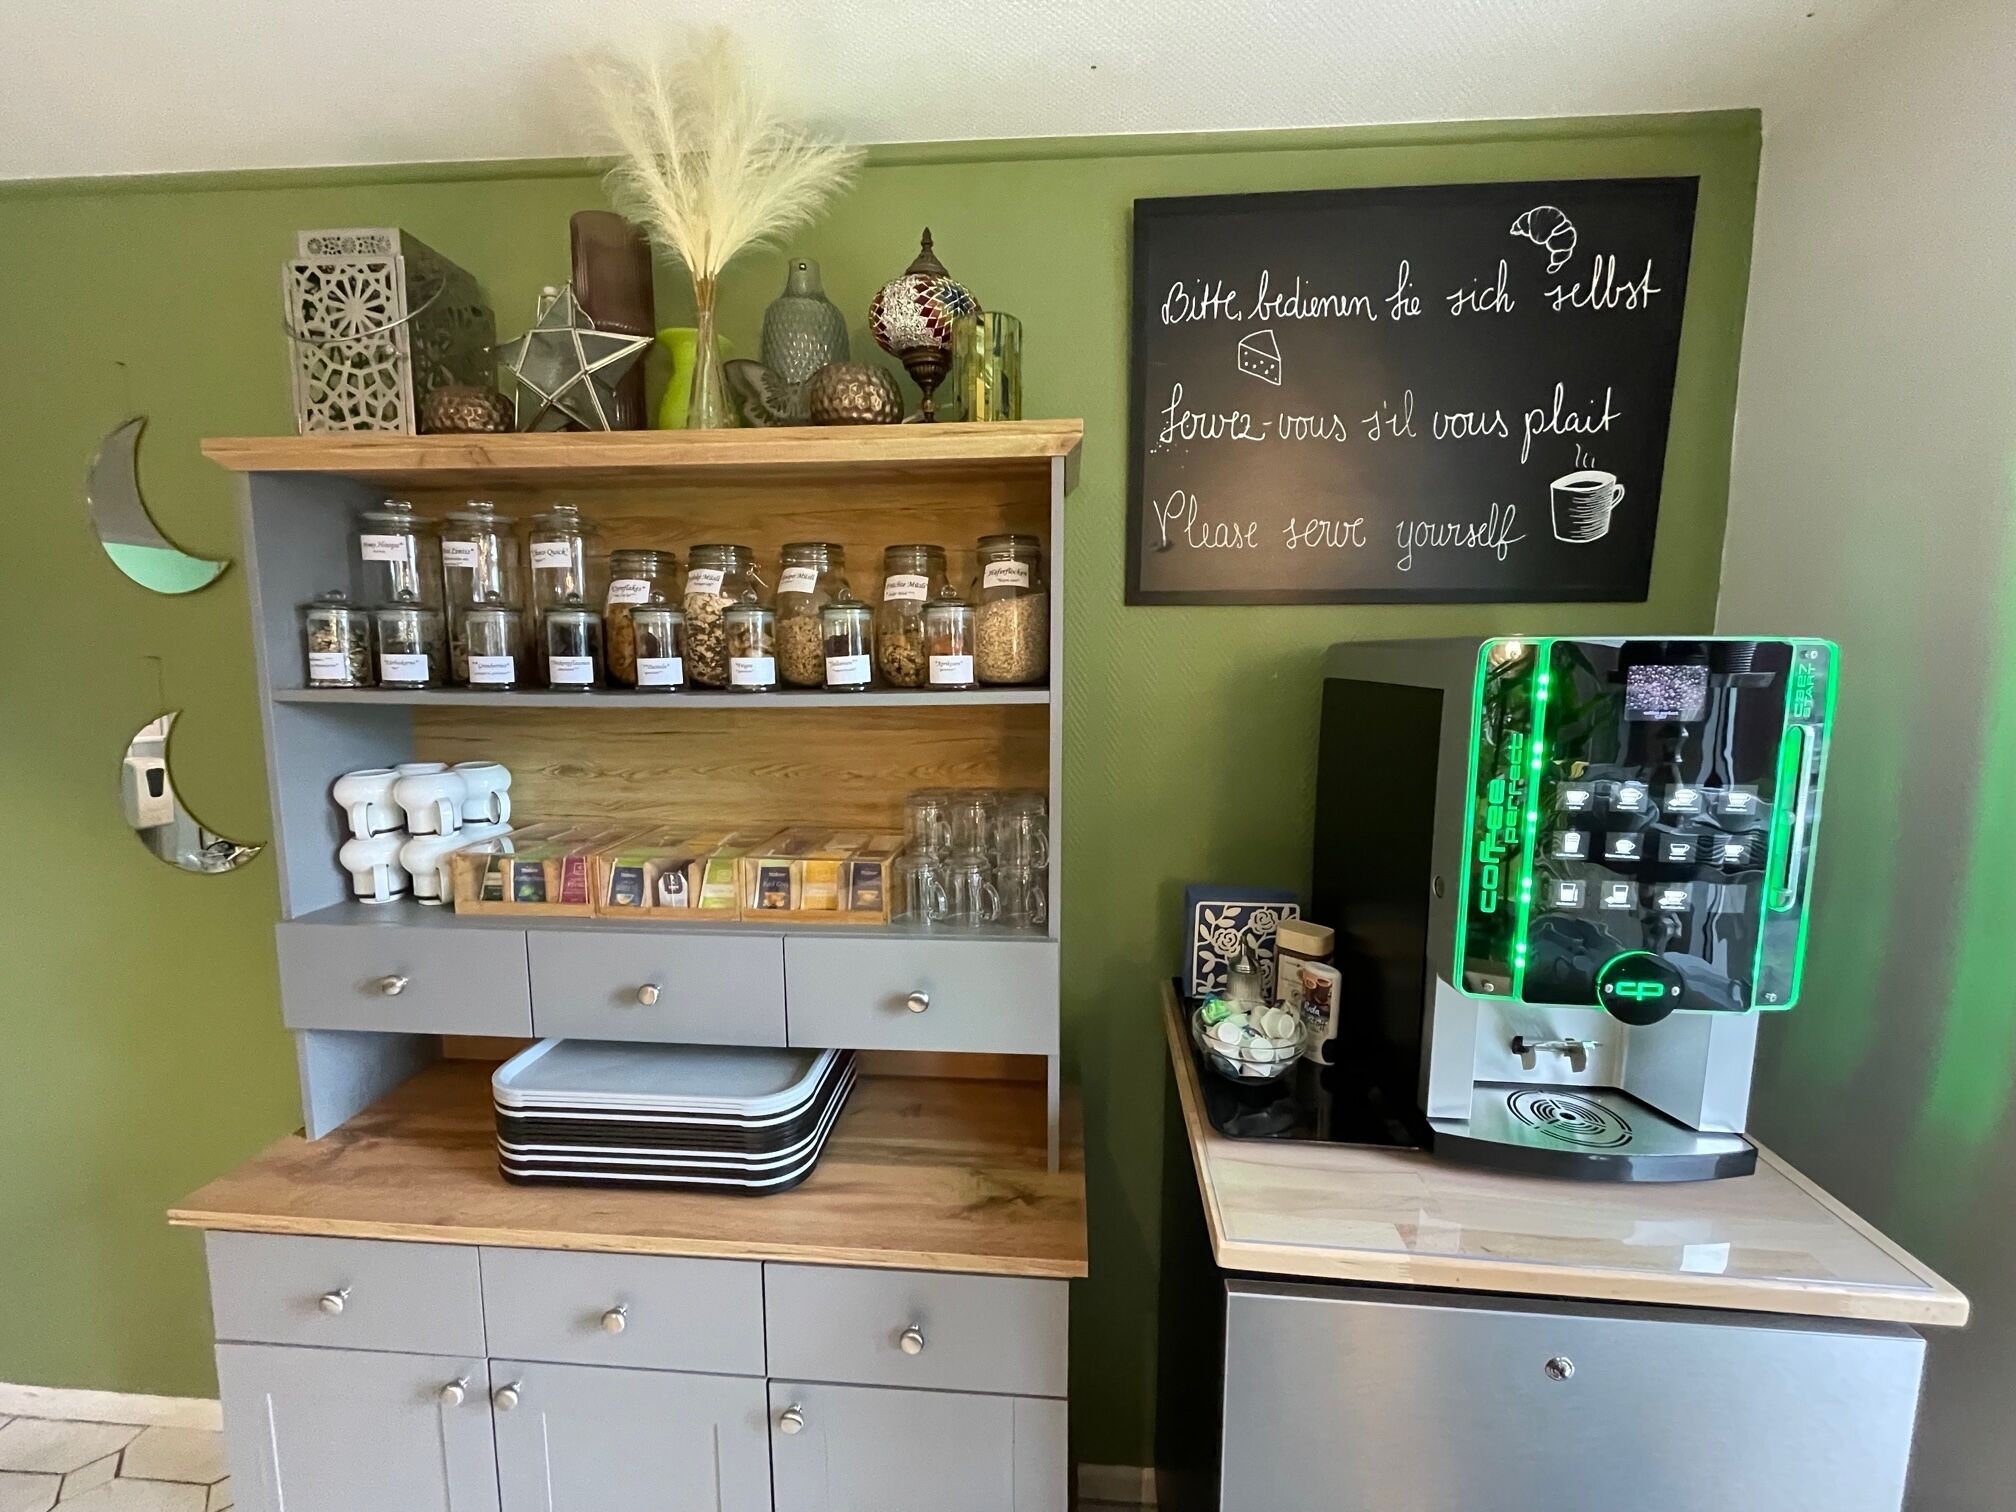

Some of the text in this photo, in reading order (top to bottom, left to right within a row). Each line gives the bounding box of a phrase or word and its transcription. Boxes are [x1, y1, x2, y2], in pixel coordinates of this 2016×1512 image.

[1161, 279, 1243, 325] Bitte,
[1247, 269, 1378, 322] bedienen
[1445, 258, 1516, 317] sich
[1543, 253, 1662, 312] selbst
[1361, 389, 1417, 442] s'il
[1432, 409, 1509, 440] vous
[1152, 489, 1528, 573] Please serve yourself
[1504, 732, 1525, 843] perfect
[1479, 778, 1508, 914] coffee
[1615, 981, 1665, 1001] cp
